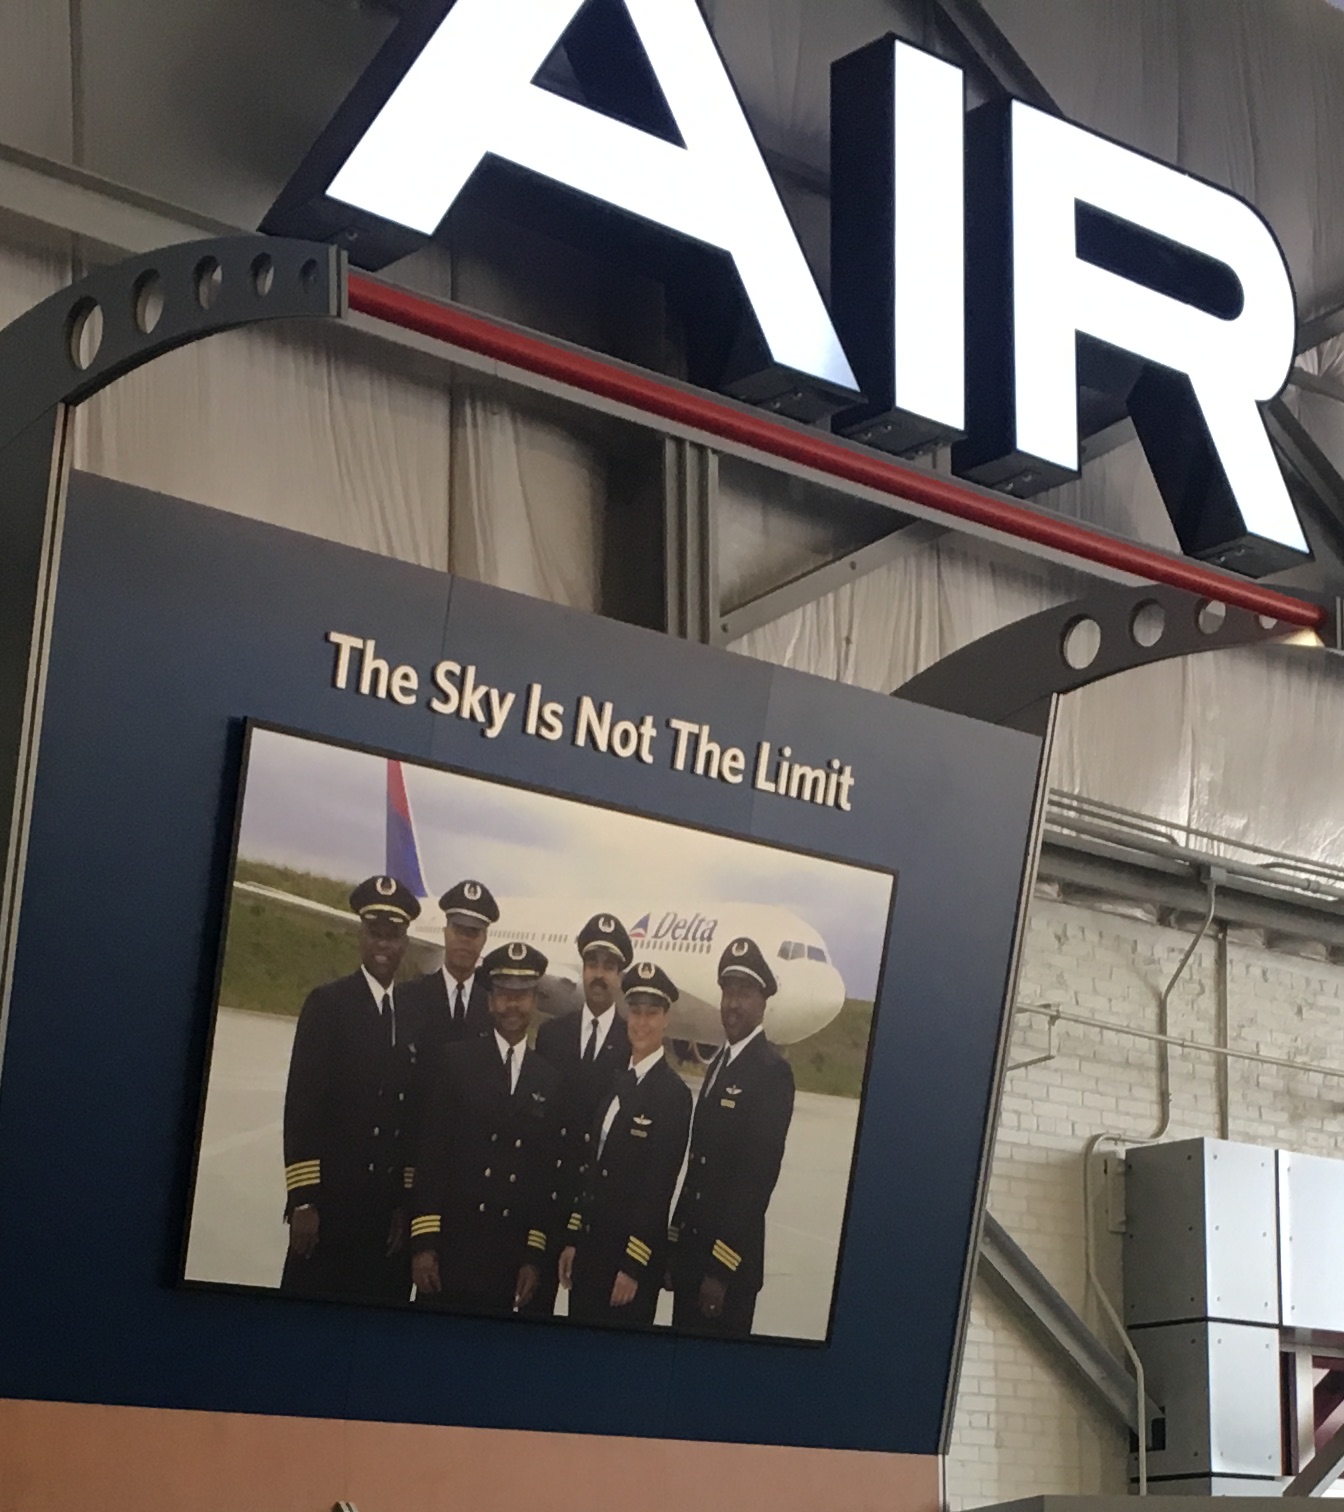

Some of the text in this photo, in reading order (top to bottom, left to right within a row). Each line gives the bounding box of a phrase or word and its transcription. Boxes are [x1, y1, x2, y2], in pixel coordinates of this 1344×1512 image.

[321, 0, 1312, 560] AIR
[327, 631, 855, 811] The Sky Is Not The Limit
[651, 911, 718, 942] Delta
